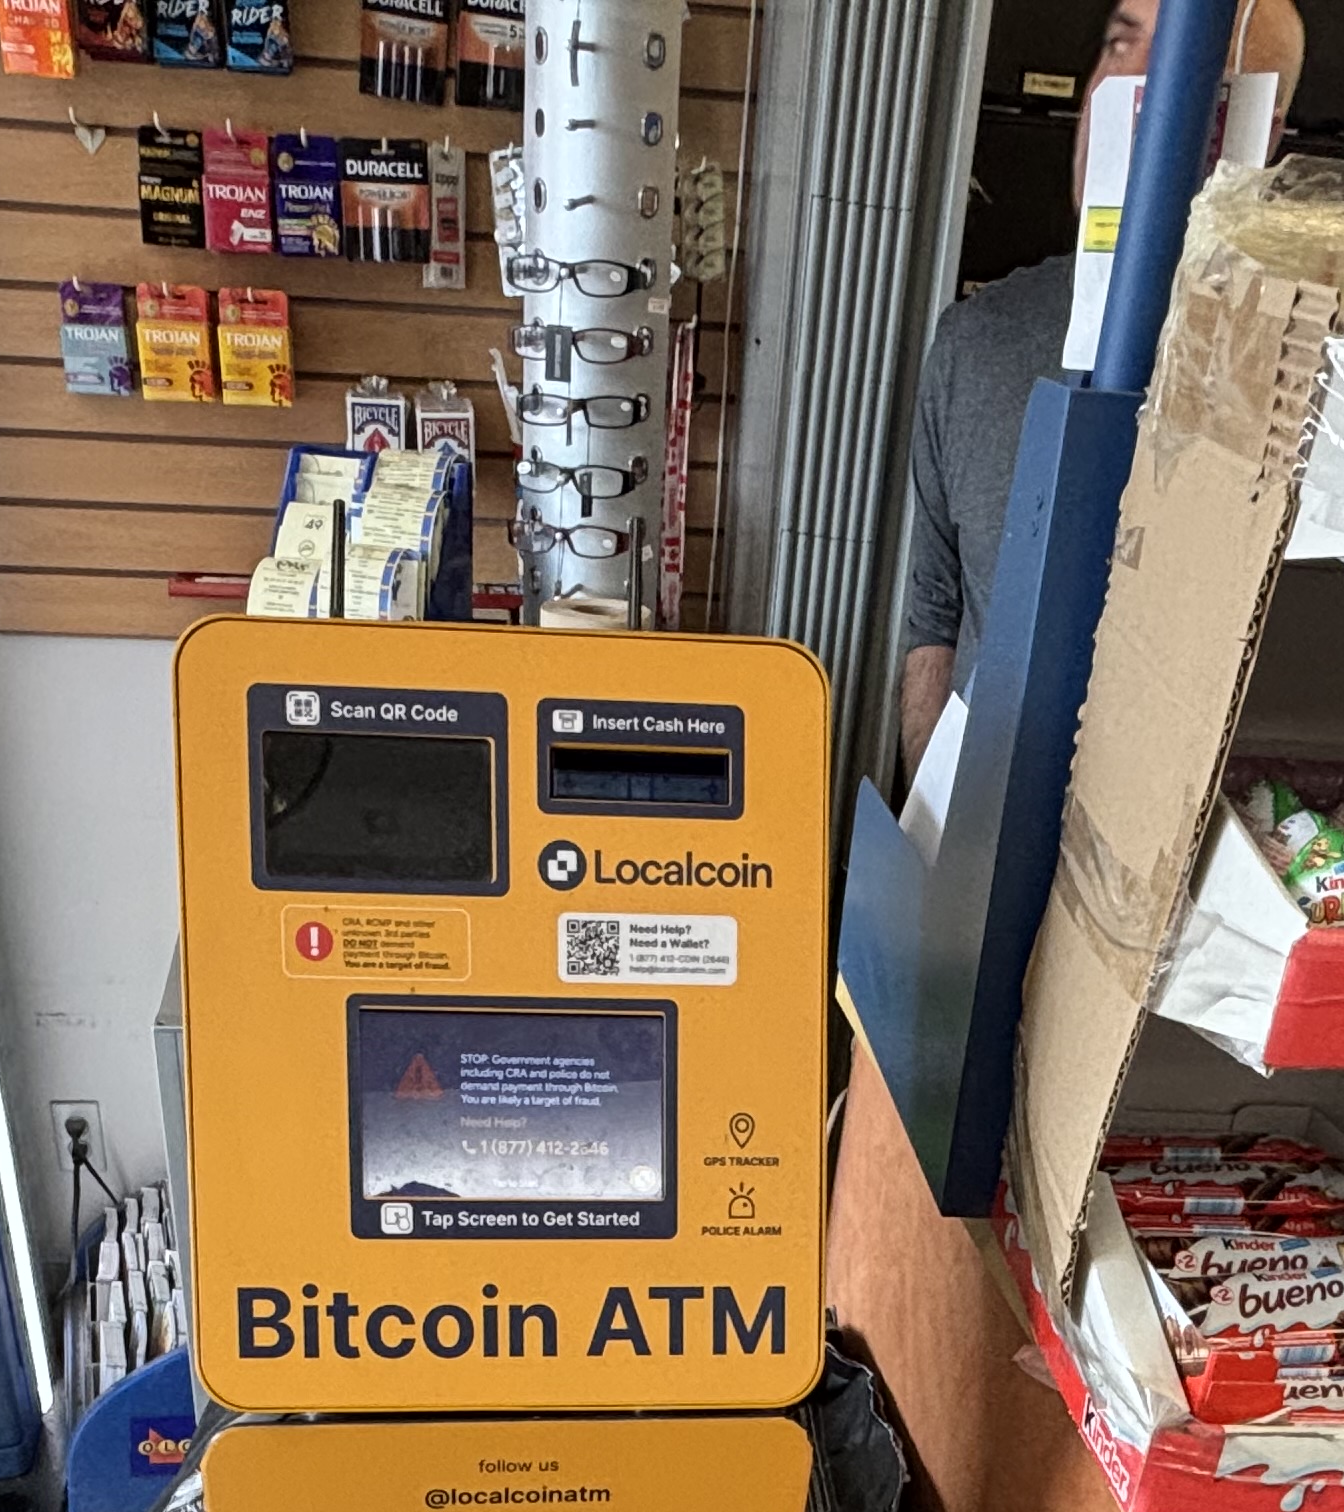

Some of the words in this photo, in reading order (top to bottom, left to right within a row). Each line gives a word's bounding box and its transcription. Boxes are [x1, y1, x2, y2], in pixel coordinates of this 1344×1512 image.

[4, 0, 62, 14] TROJAN
[157, 0, 209, 16] RIDER
[232, 6, 284, 24] RIDER
[509, 27, 517, 38] 5
[345, 159, 423, 179] DURACELL
[140, 184, 200, 204] MAGNUM
[206, 184, 267, 202] TROJAN
[278, 184, 334, 200] TROJAN
[240, 208, 266, 220] ENZ
[64, 326, 119, 343] TROJAN
[142, 329, 201, 345] TROJAN
[225, 333, 283, 349] TROJAN
[355, 405, 399, 430] BICYCLE
[423, 420, 468, 443] BICYCLE
[330, 701, 379, 723] Scan
[381, 703, 409, 723] QR
[412, 704, 458, 723] Code
[592, 714, 640, 733] Insert
[642, 715, 681, 733] Cash
[684, 718, 726, 735] Here
[594, 850, 773, 890] Localcoin
[629, 924, 657, 934] Need
[661, 924, 691, 936] Help?
[343, 940, 356, 948] DO
[359, 940, 378, 948] NOT
[629, 938, 657, 948] Need
[661, 940, 667, 948] a
[670, 939, 710, 949] Wallet?
[344, 960, 360, 968] You
[492, 1055, 551, 1065] Government
[461, 1068, 503, 1080] including
[505, 1068, 527, 1078] CRA
[529, 1069, 547, 1079] and
[549, 1069, 578, 1080] police
[579, 1070, 592, 1079] do
[594, 1071, 610, 1079] not
[461, 1082, 500, 1091] demand
[501, 1083, 543, 1093] payment
[545, 1083, 582, 1094] through
[461, 1095, 480, 1104] You
[481, 1096, 496, 1104] are
[524, 1097, 530, 1105] a
[531, 1096, 560, 1107] target
[562, 1096, 572, 1106] of
[461, 1117, 492, 1128] Need
[492, 1139, 532, 1157] (877)
[703, 1156, 725, 1167] GPS
[727, 1156, 779, 1167] TRACKER
[1150, 1161, 1251, 1175] bueno
[422, 1209, 453, 1230] Tap
[457, 1209, 517, 1228] Screen
[521, 1211, 539, 1228] to
[543, 1209, 573, 1228] Get
[577, 1209, 640, 1228] Started
[701, 1226, 739, 1236] POLICE
[742, 1226, 781, 1236] ALARM
[1223, 1238, 1276, 1251] Kinder
[1201, 1251, 1309, 1276] bueno
[1239, 1279, 1344, 1318] bueno
[236, 1283, 558, 1360] Bitcoin
[586, 1285, 787, 1358] ATM
[1082, 1396, 1131, 1501] Kinder
[478, 1458, 531, 1474] follow
[535, 1459, 559, 1473] us
[423, 1485, 611, 1509] @localcoinatm
